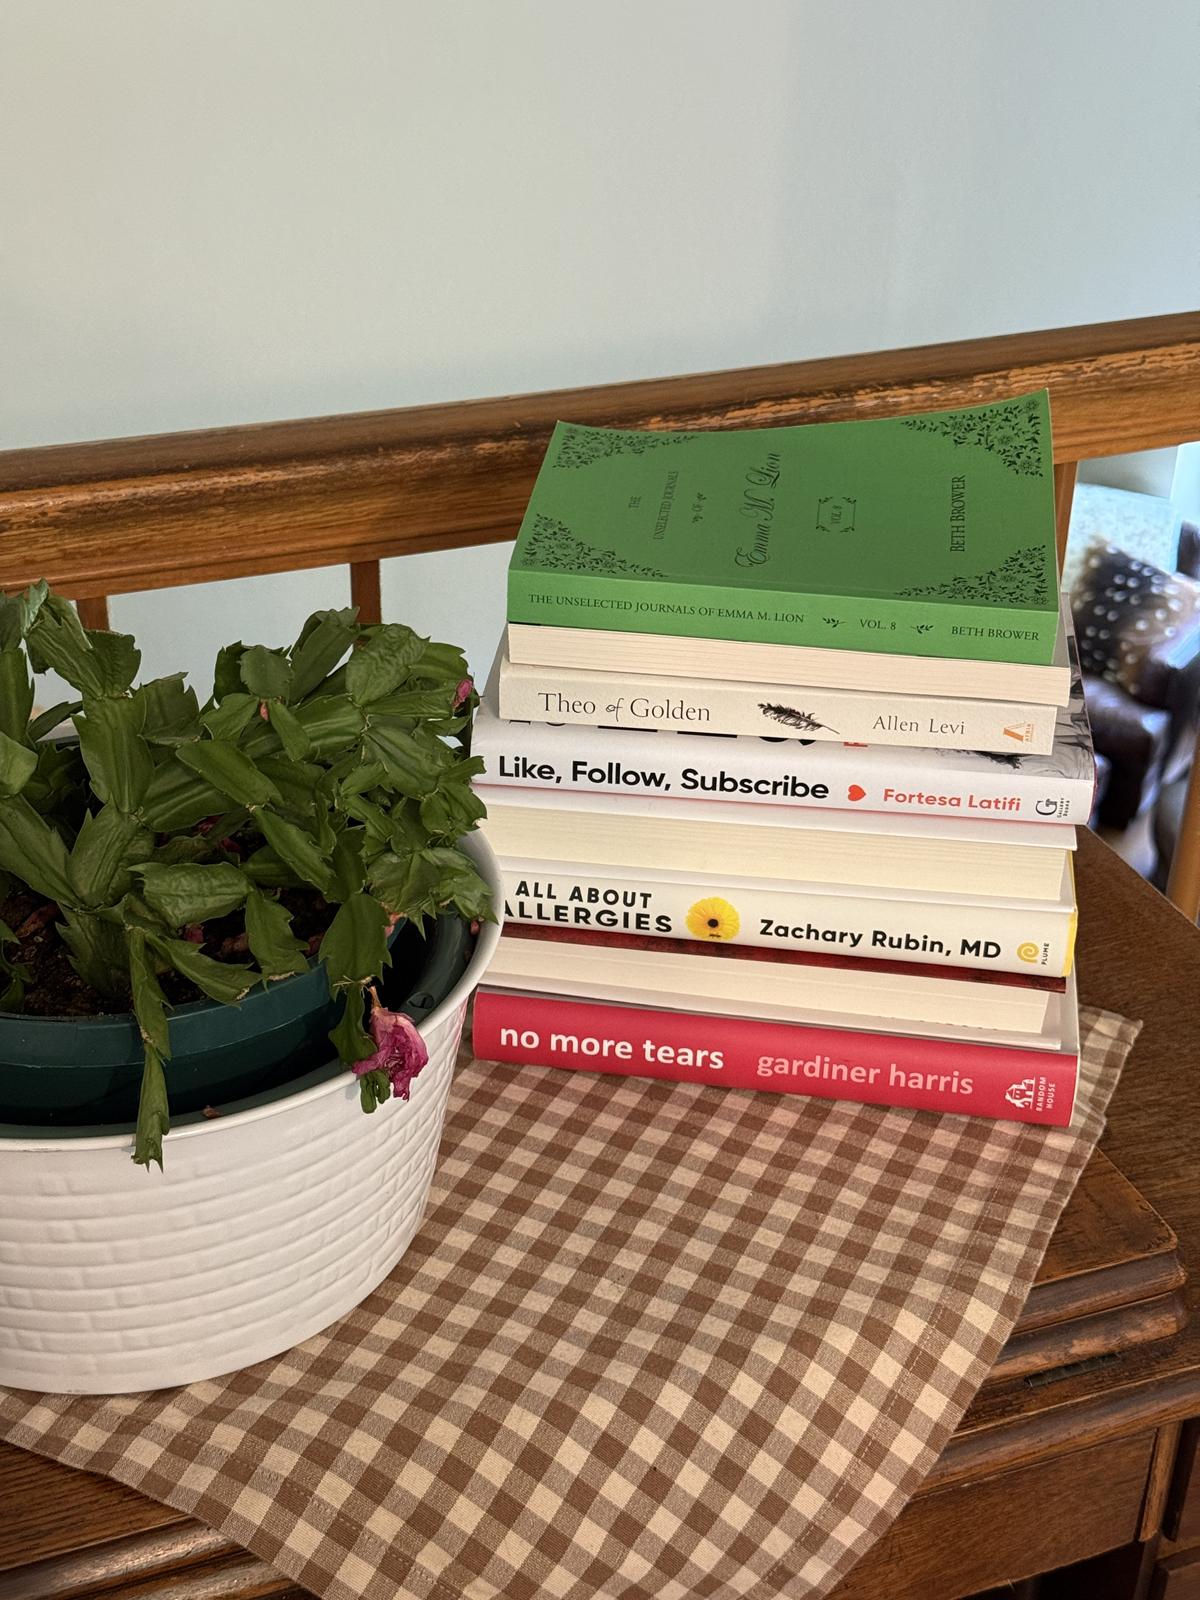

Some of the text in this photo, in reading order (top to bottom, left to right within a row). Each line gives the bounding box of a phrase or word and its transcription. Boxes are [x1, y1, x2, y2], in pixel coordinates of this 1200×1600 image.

[628, 496, 642, 508] THE
[653, 471, 679, 540] UNSELECTED JOURNALS
[734, 453, 781, 568] Emma M. Lion
[950, 475, 966, 552] BETH BROWER
[528, 593, 1040, 641] THE UNSELECTED JOURNALS OF EMMA M. LION VOL. 8 BETH BROWER
[537, 692, 965, 735] Theo of Golden Allen Levi
[499, 755, 1022, 812] Like, Follow, Subscribe Fortesa Latifi
[515, 880, 652, 909] ALL ABOUT
[759, 919, 1001, 959] Zachary Rubin, MD
[1041, 942, 1050, 966] PLUME
[500, 1028, 974, 1095] no more tears gardiner harris
[1035, 1076, 1047, 1112] RANDOM
[1046, 1082, 1056, 1109] HOUSE
